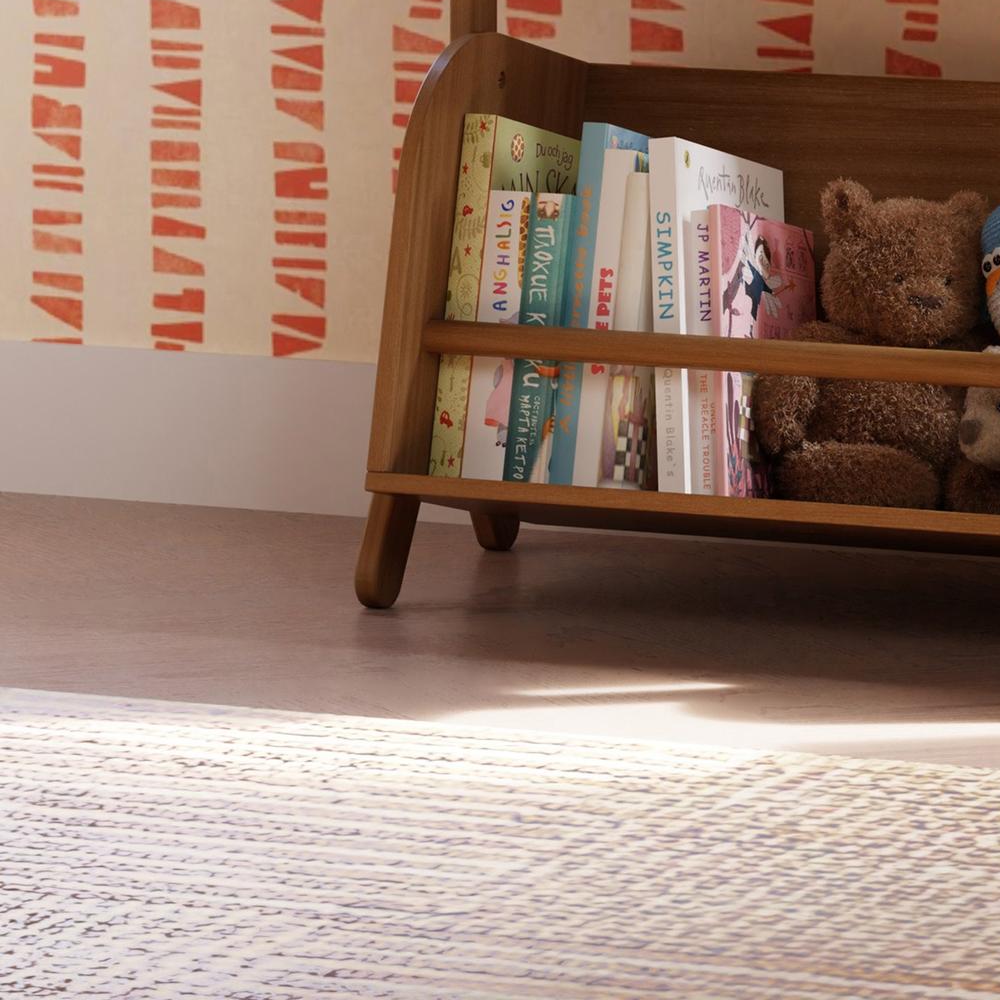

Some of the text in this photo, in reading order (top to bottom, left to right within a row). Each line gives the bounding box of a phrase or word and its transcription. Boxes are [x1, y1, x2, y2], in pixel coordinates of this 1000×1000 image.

[735, 174, 770, 209] Blake
[596, 267, 614, 317] PETS
[656, 211, 674, 320] SIMPKIN
[696, 223, 712, 322] JP MARTIN
[662, 368, 677, 477] Quentin Blake's
[699, 374, 712, 489] THE TREACLE TROUBLE
